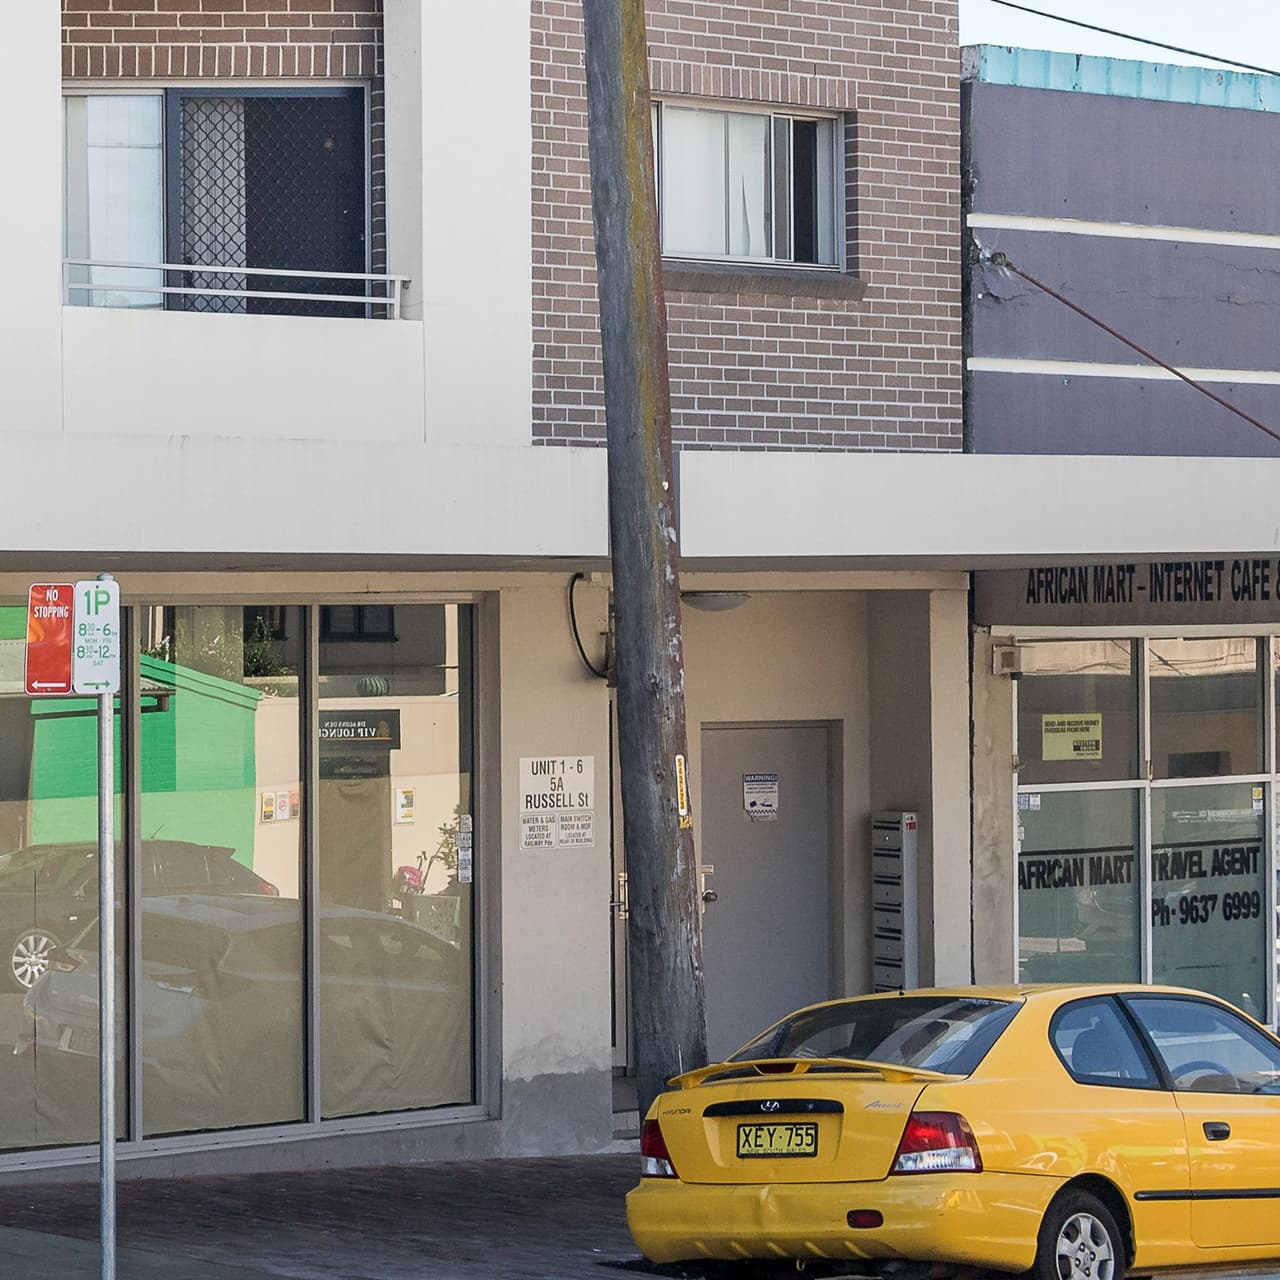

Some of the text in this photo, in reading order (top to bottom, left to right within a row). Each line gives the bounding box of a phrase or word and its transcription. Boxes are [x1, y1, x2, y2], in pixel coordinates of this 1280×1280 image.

[1026, 566, 1088, 604] AFRICAN
[1093, 564, 1135, 603] MART
[1150, 560, 1225, 602] INTERNET
[1231, 560, 1270, 601] CAFE
[46, 589, 59, 602] NO
[84, 590, 111, 615] 1P
[34, 606, 69, 618] STOPPING
[531, 760, 557, 775] UNIT
[560, 759, 565, 774] 1
[576, 759, 583, 774] 6
[550, 777, 564, 792] 5A
[525, 792, 589, 809] RUSSELL St
[1019, 847, 1260, 890] AFRICAN MART TRAVEL AGENT
[1180, 895, 1218, 924] 9637
[1223, 891, 1260, 921] 6999
